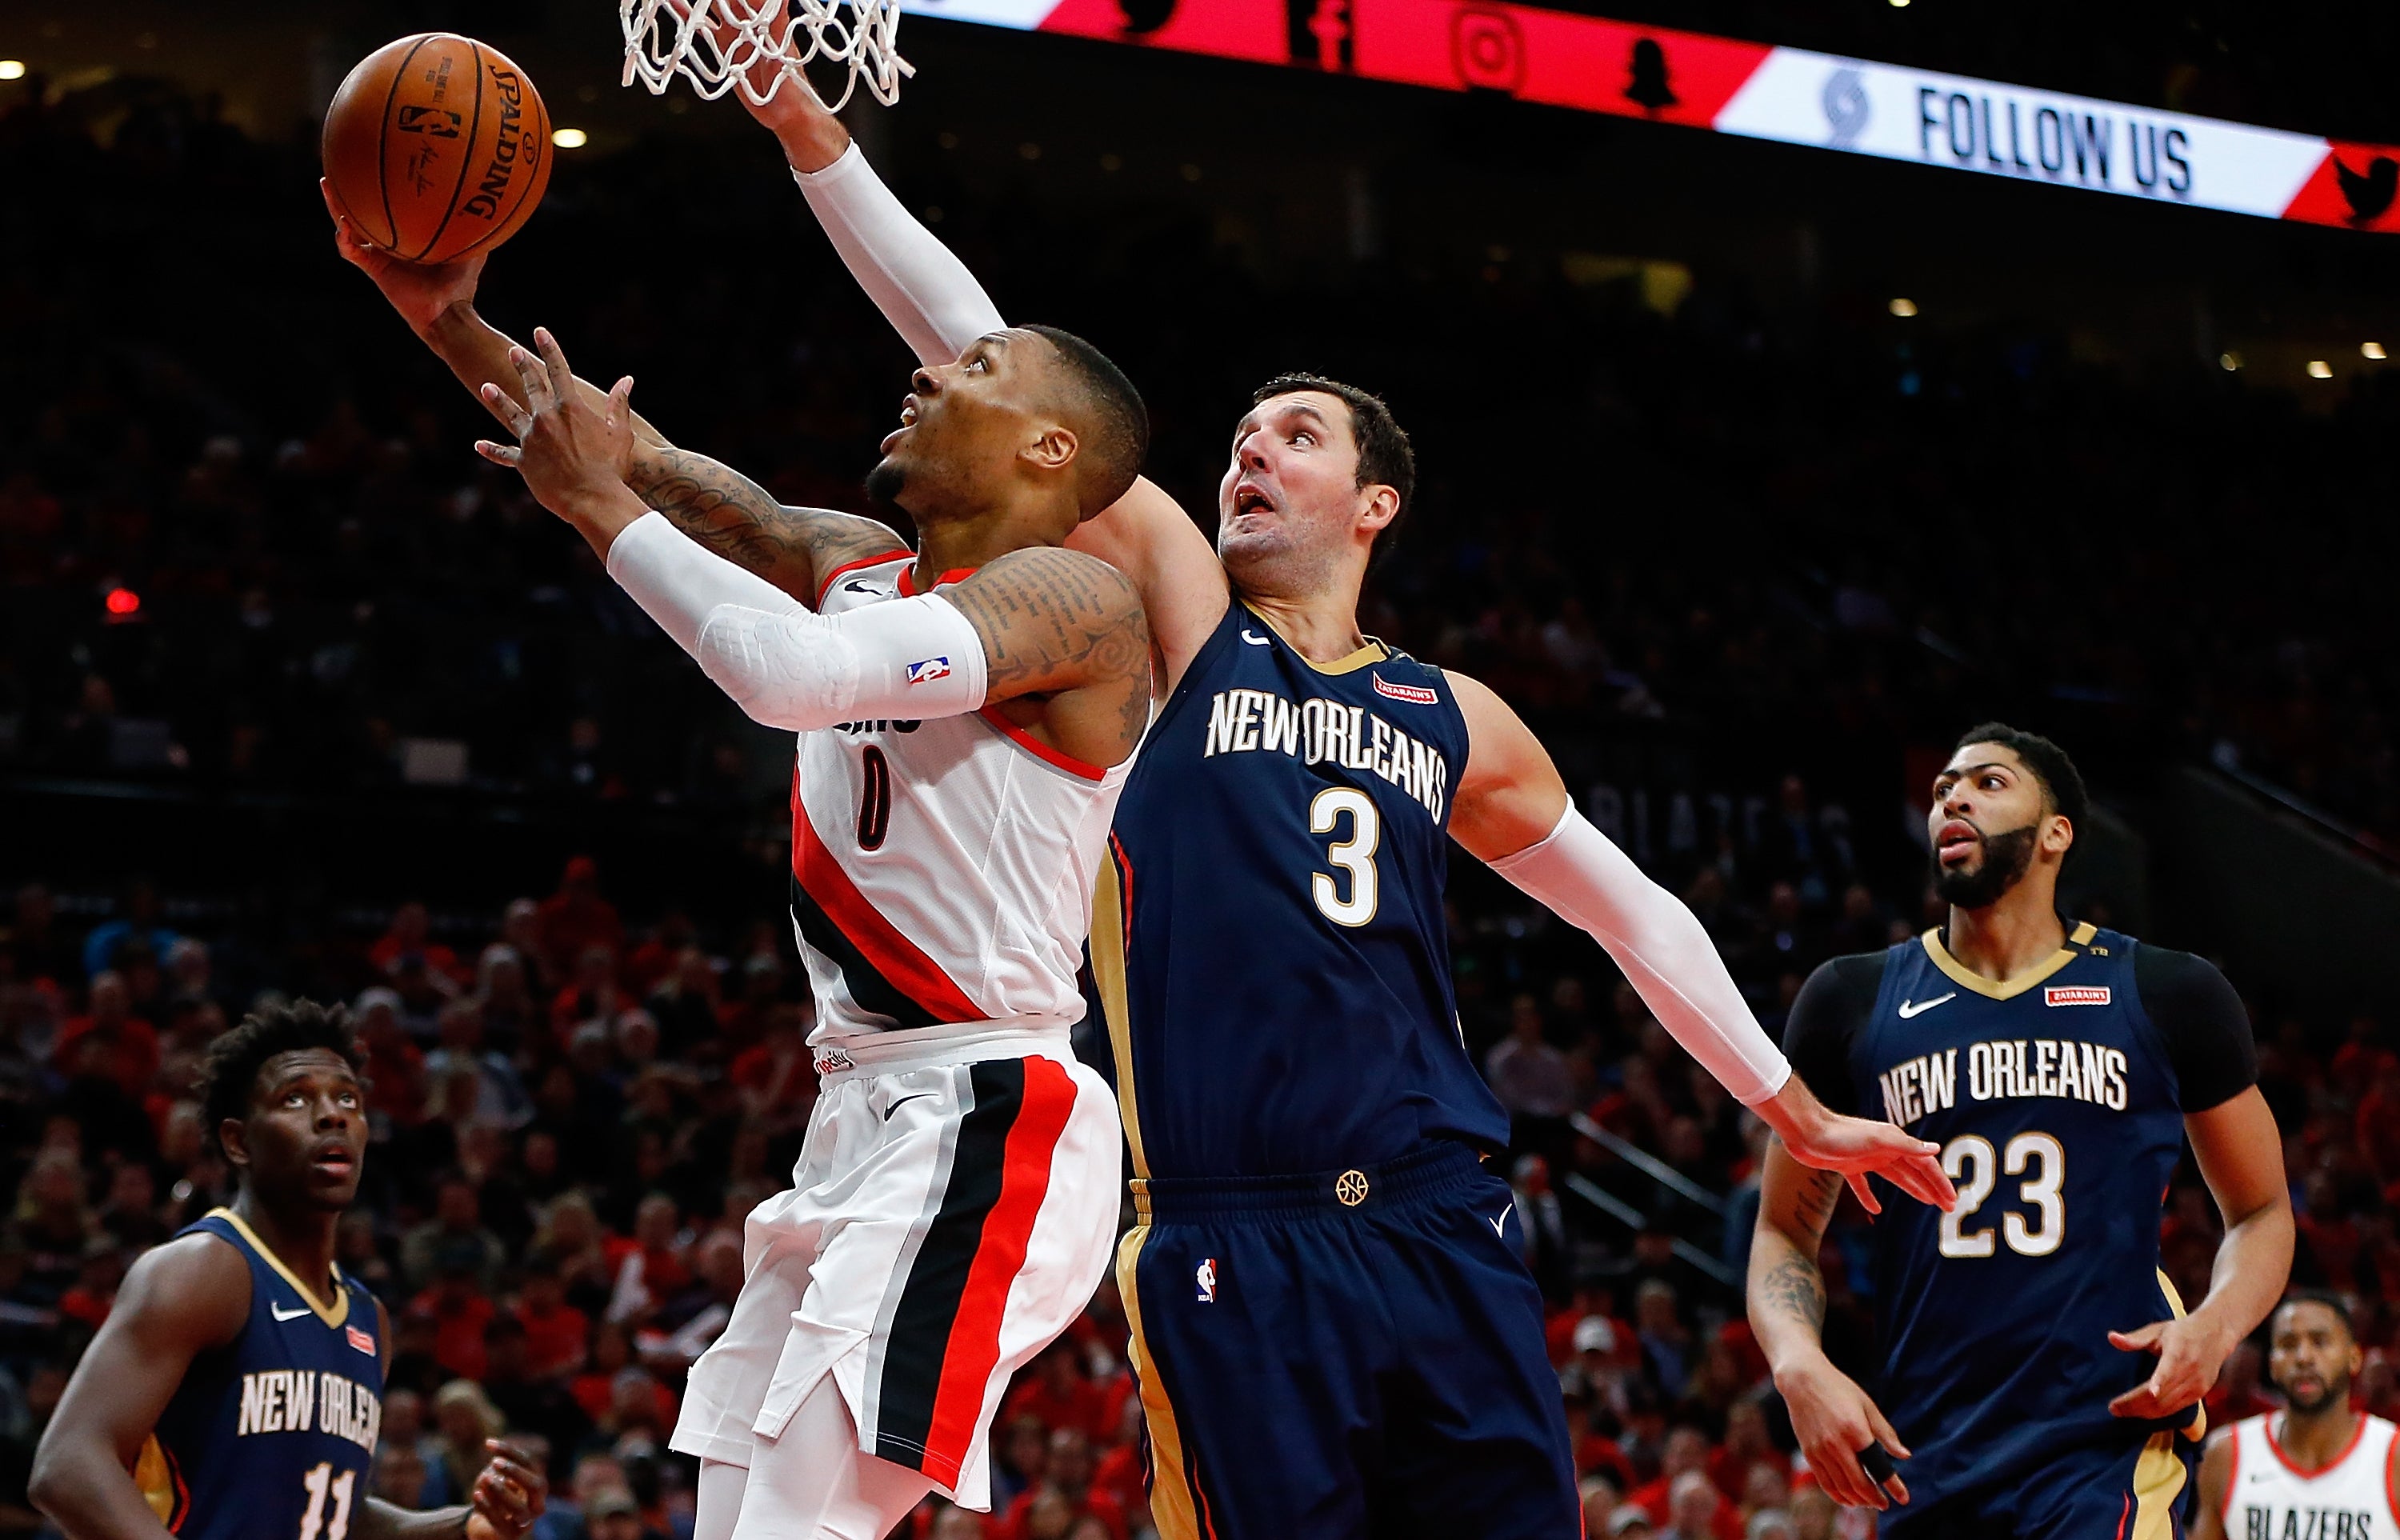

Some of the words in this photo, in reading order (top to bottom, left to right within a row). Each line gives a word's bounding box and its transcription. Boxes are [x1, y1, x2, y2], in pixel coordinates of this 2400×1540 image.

[462, 64, 521, 221] SPALDING
[1920, 87, 2111, 181] FOLLOW
[2130, 122, 2190, 192] US
[857, 745, 891, 851] 0
[1204, 690, 1300, 758] NEW
[1301, 698, 1446, 826] ORLEANS
[1310, 787, 1379, 927] 3
[1879, 1047, 1958, 1128] NEW
[1968, 1040, 2128, 1111] ORLEANS
[1938, 1131, 2066, 1258] 23
[237, 1370, 315, 1437] NEW
[299, 1462, 357, 1540] 11
